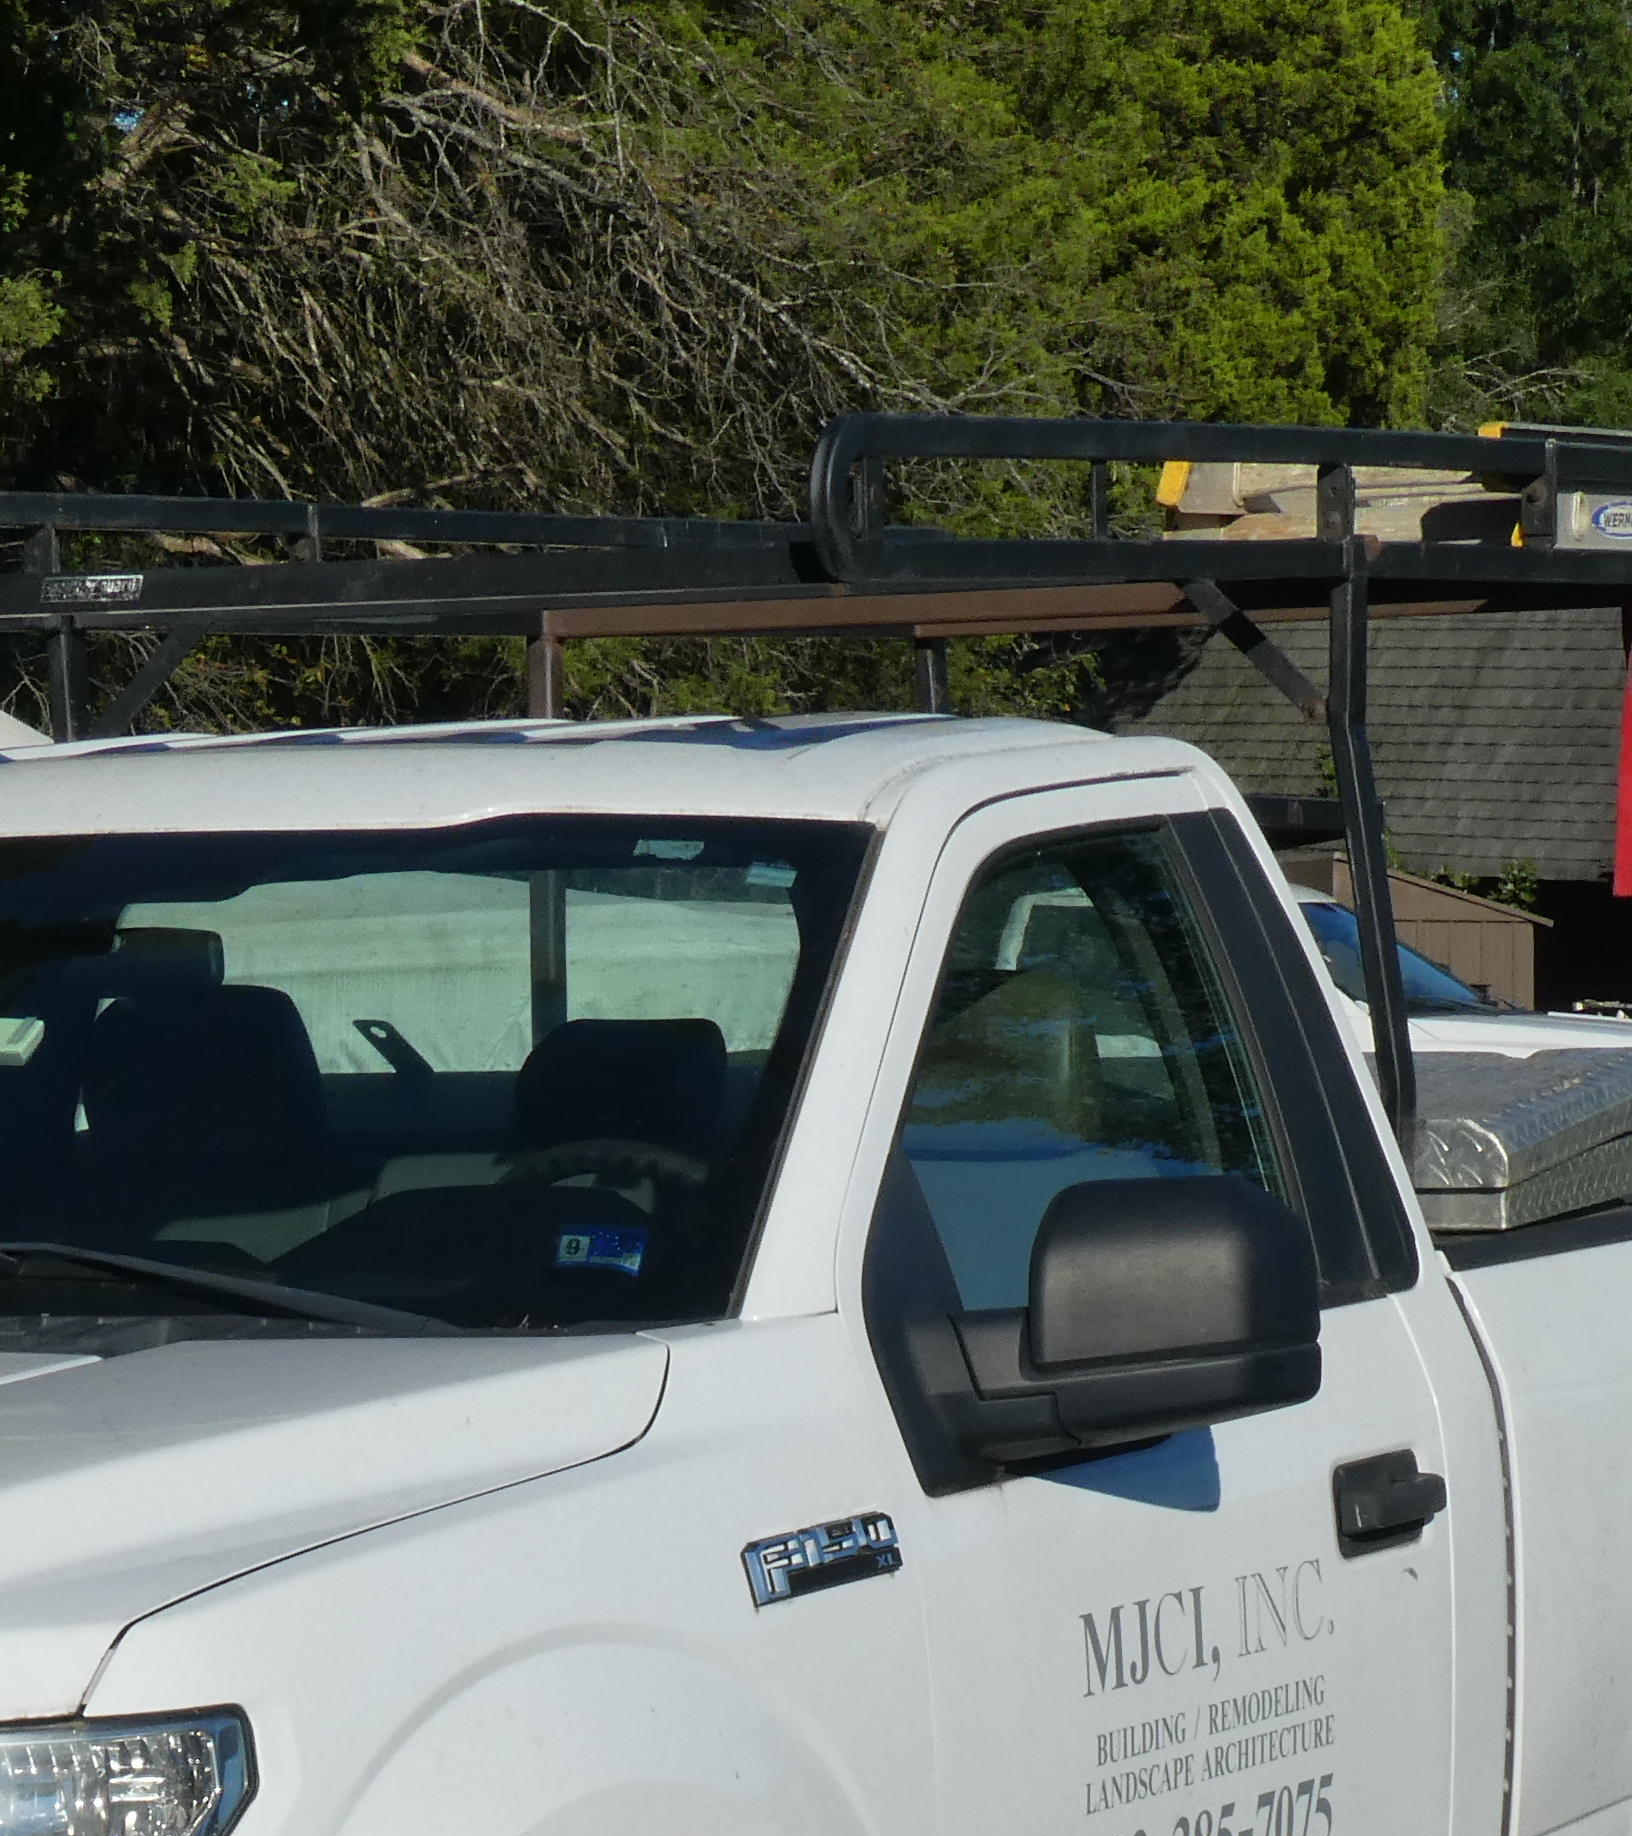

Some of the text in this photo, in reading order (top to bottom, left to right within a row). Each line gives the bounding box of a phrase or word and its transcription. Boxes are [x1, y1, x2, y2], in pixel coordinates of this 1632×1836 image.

[1078, 1557, 1336, 1698] MJCI, INC.
[1084, 1713, 1336, 1816] LANDSCAPE ARCHITECTURE
[1096, 1711, 1187, 1767] BUILDING
[1207, 1674, 1326, 1737] REMODELING
